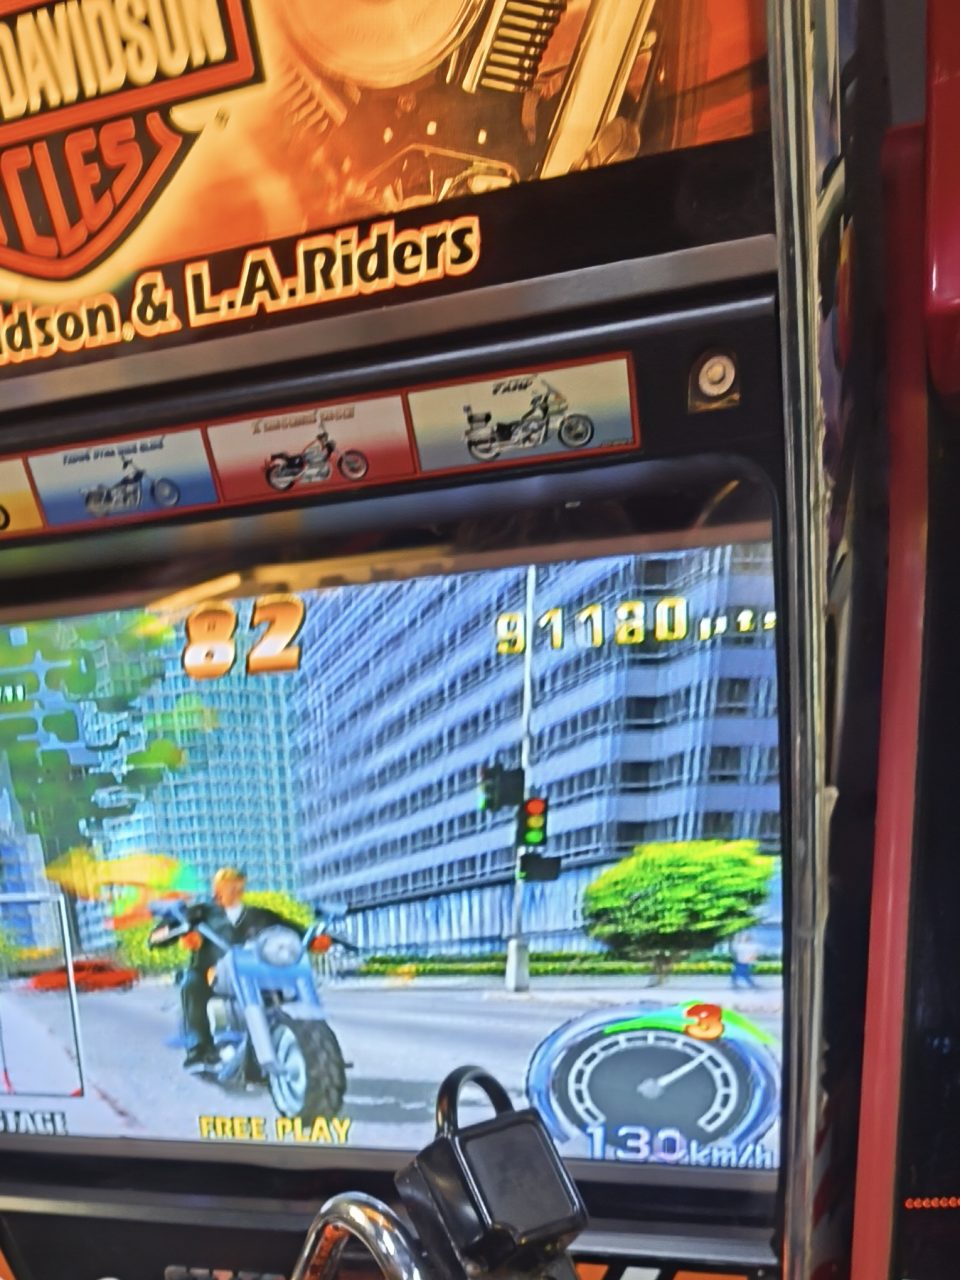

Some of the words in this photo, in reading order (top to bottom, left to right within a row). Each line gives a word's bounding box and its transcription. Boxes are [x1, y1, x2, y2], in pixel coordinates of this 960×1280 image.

[131, 271, 182, 337] &
[182, 592, 304, 681] 82
[683, 1003, 725, 1041] 3
[198, 1114, 267, 1142] FREE
[274, 1115, 354, 1144] PLAY
[585, 1124, 688, 1161] 130
